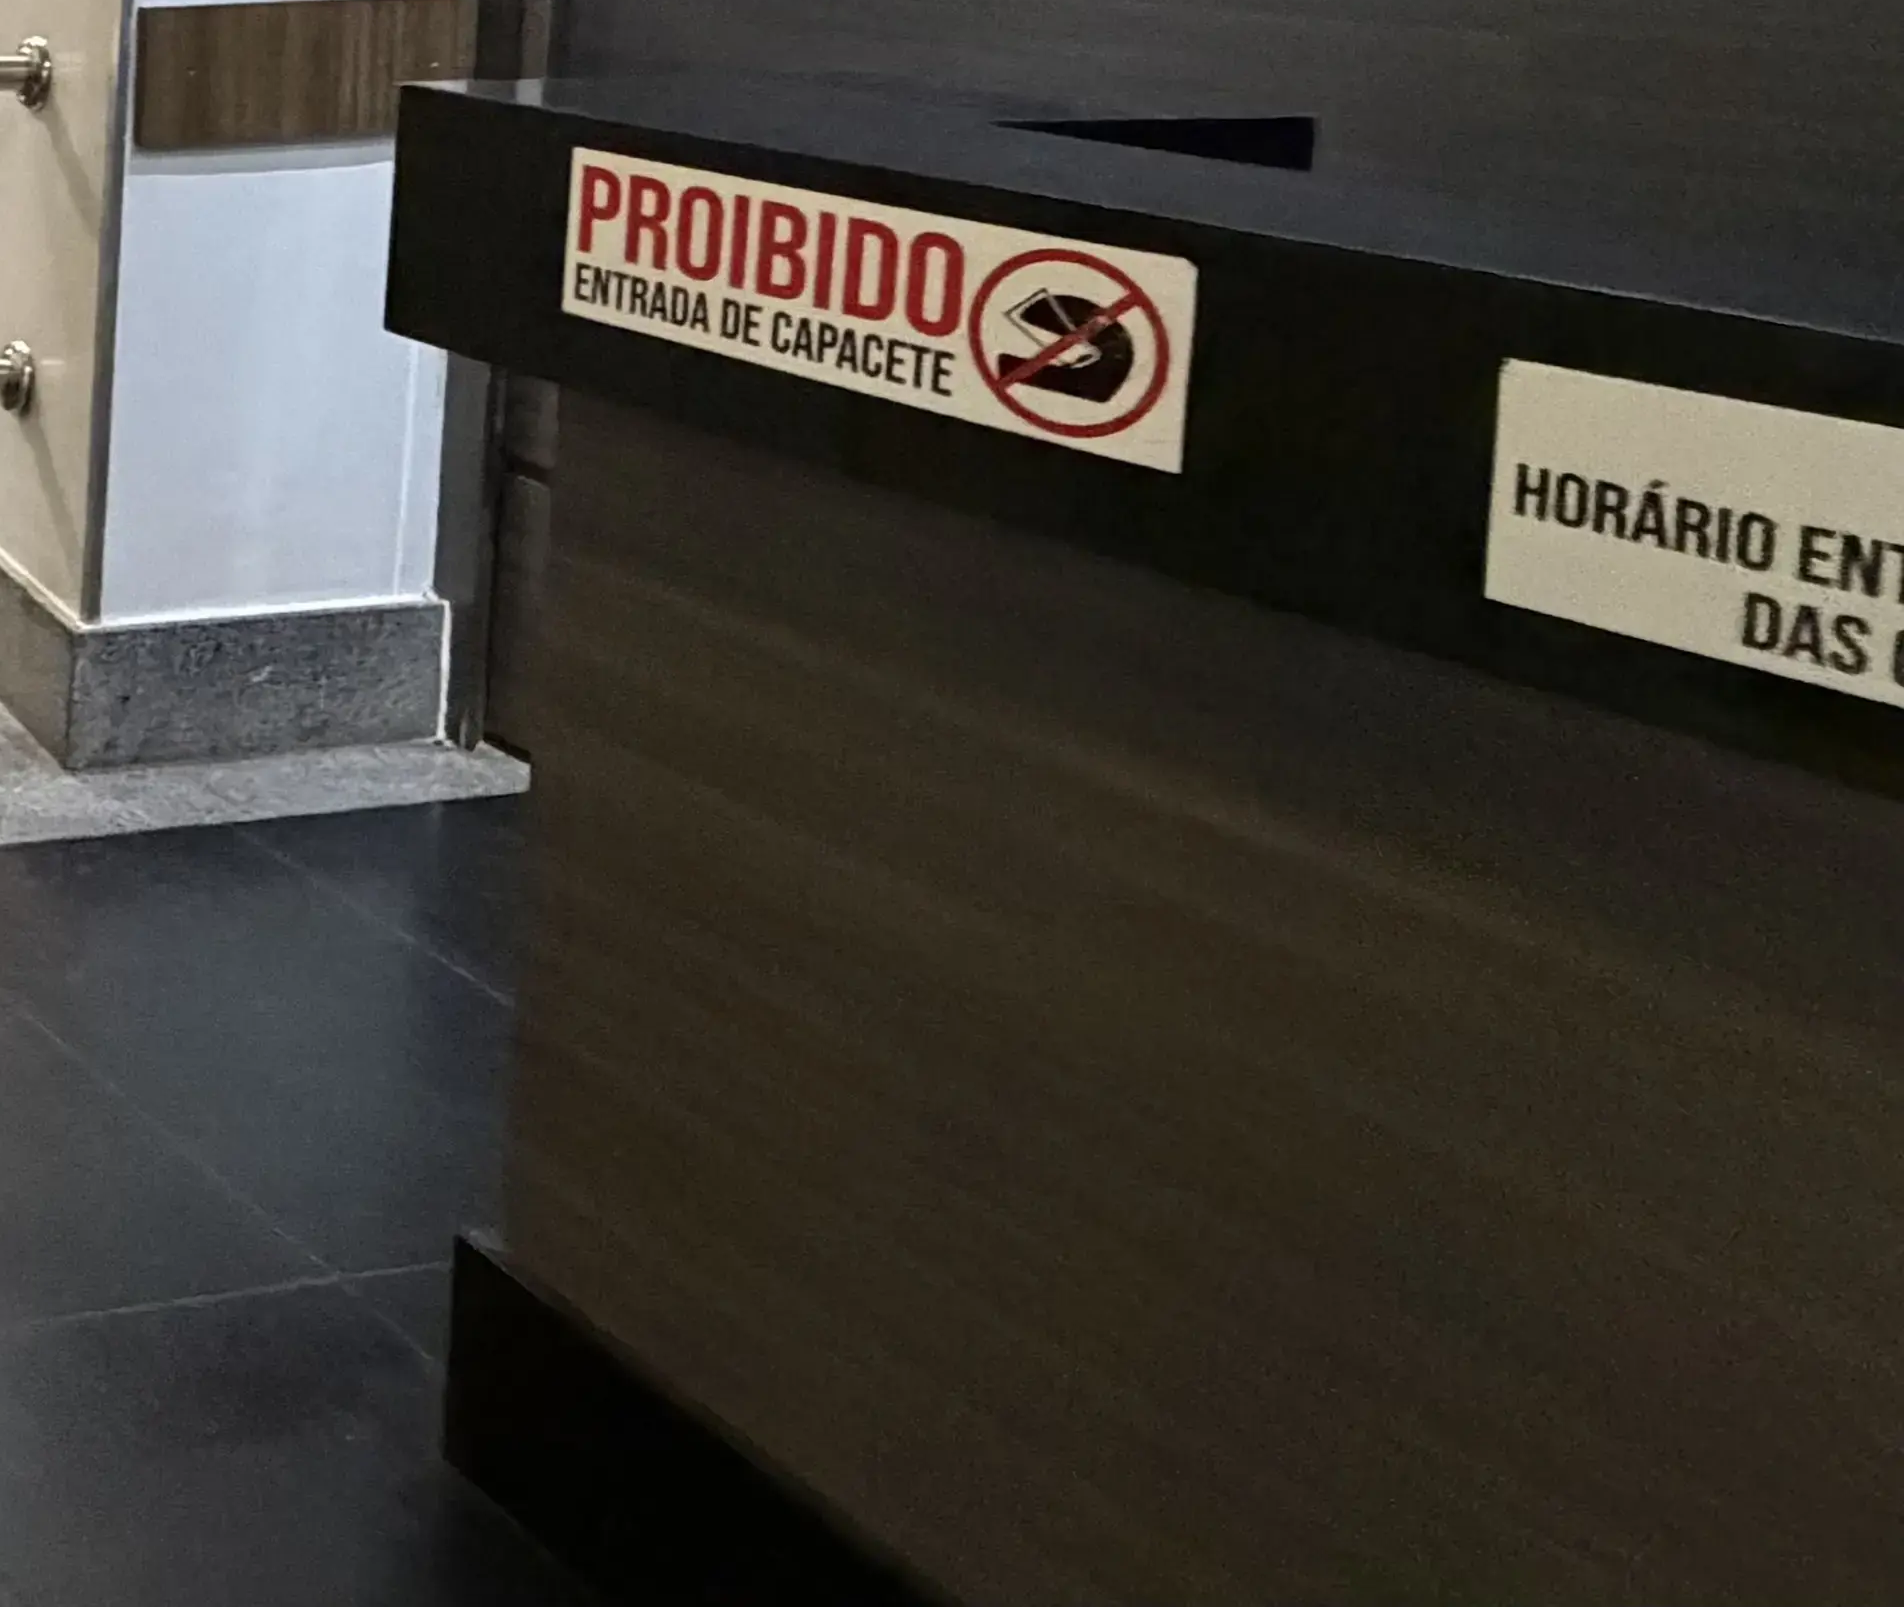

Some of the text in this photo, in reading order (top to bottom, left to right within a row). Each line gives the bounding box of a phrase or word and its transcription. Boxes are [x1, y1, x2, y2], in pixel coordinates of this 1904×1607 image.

[576, 165, 966, 338] PROIBIDO
[573, 263, 955, 397] ENTRADA DE CAPACETE
[1513, 462, 1779, 572] HORÁRIO
[1742, 591, 1872, 676] DAS
